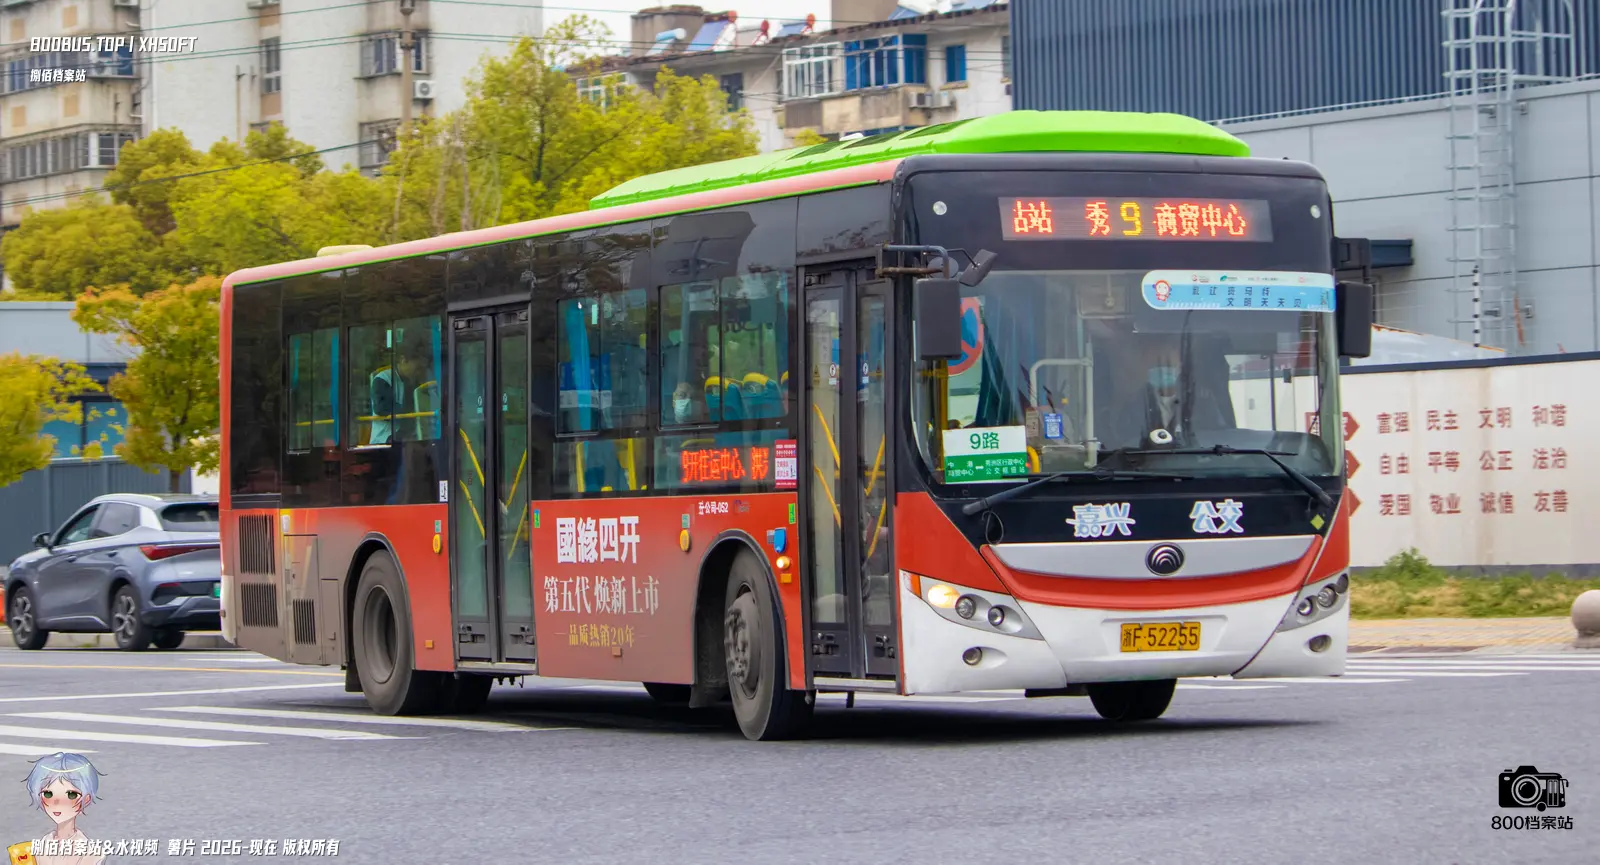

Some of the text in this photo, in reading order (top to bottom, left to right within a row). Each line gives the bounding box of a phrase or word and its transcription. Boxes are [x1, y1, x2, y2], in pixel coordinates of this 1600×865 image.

[1119, 202, 1143, 236] 9
[1153, 203, 1246, 236] 商贸中心
[1377, 404, 1567, 434] 富强 民主 文明 和谐
[970, 432, 999, 449] 9路
[1379, 447, 1567, 475] 自由 平等 公正 法治
[1066, 498, 1244, 538] 嘉兴 公交
[1379, 489, 1568, 516] 爱国 敬业 诚信 友善
[556, 516, 640, 564] 國緣四开
[544, 575, 660, 615] 第五代 焕新上市
